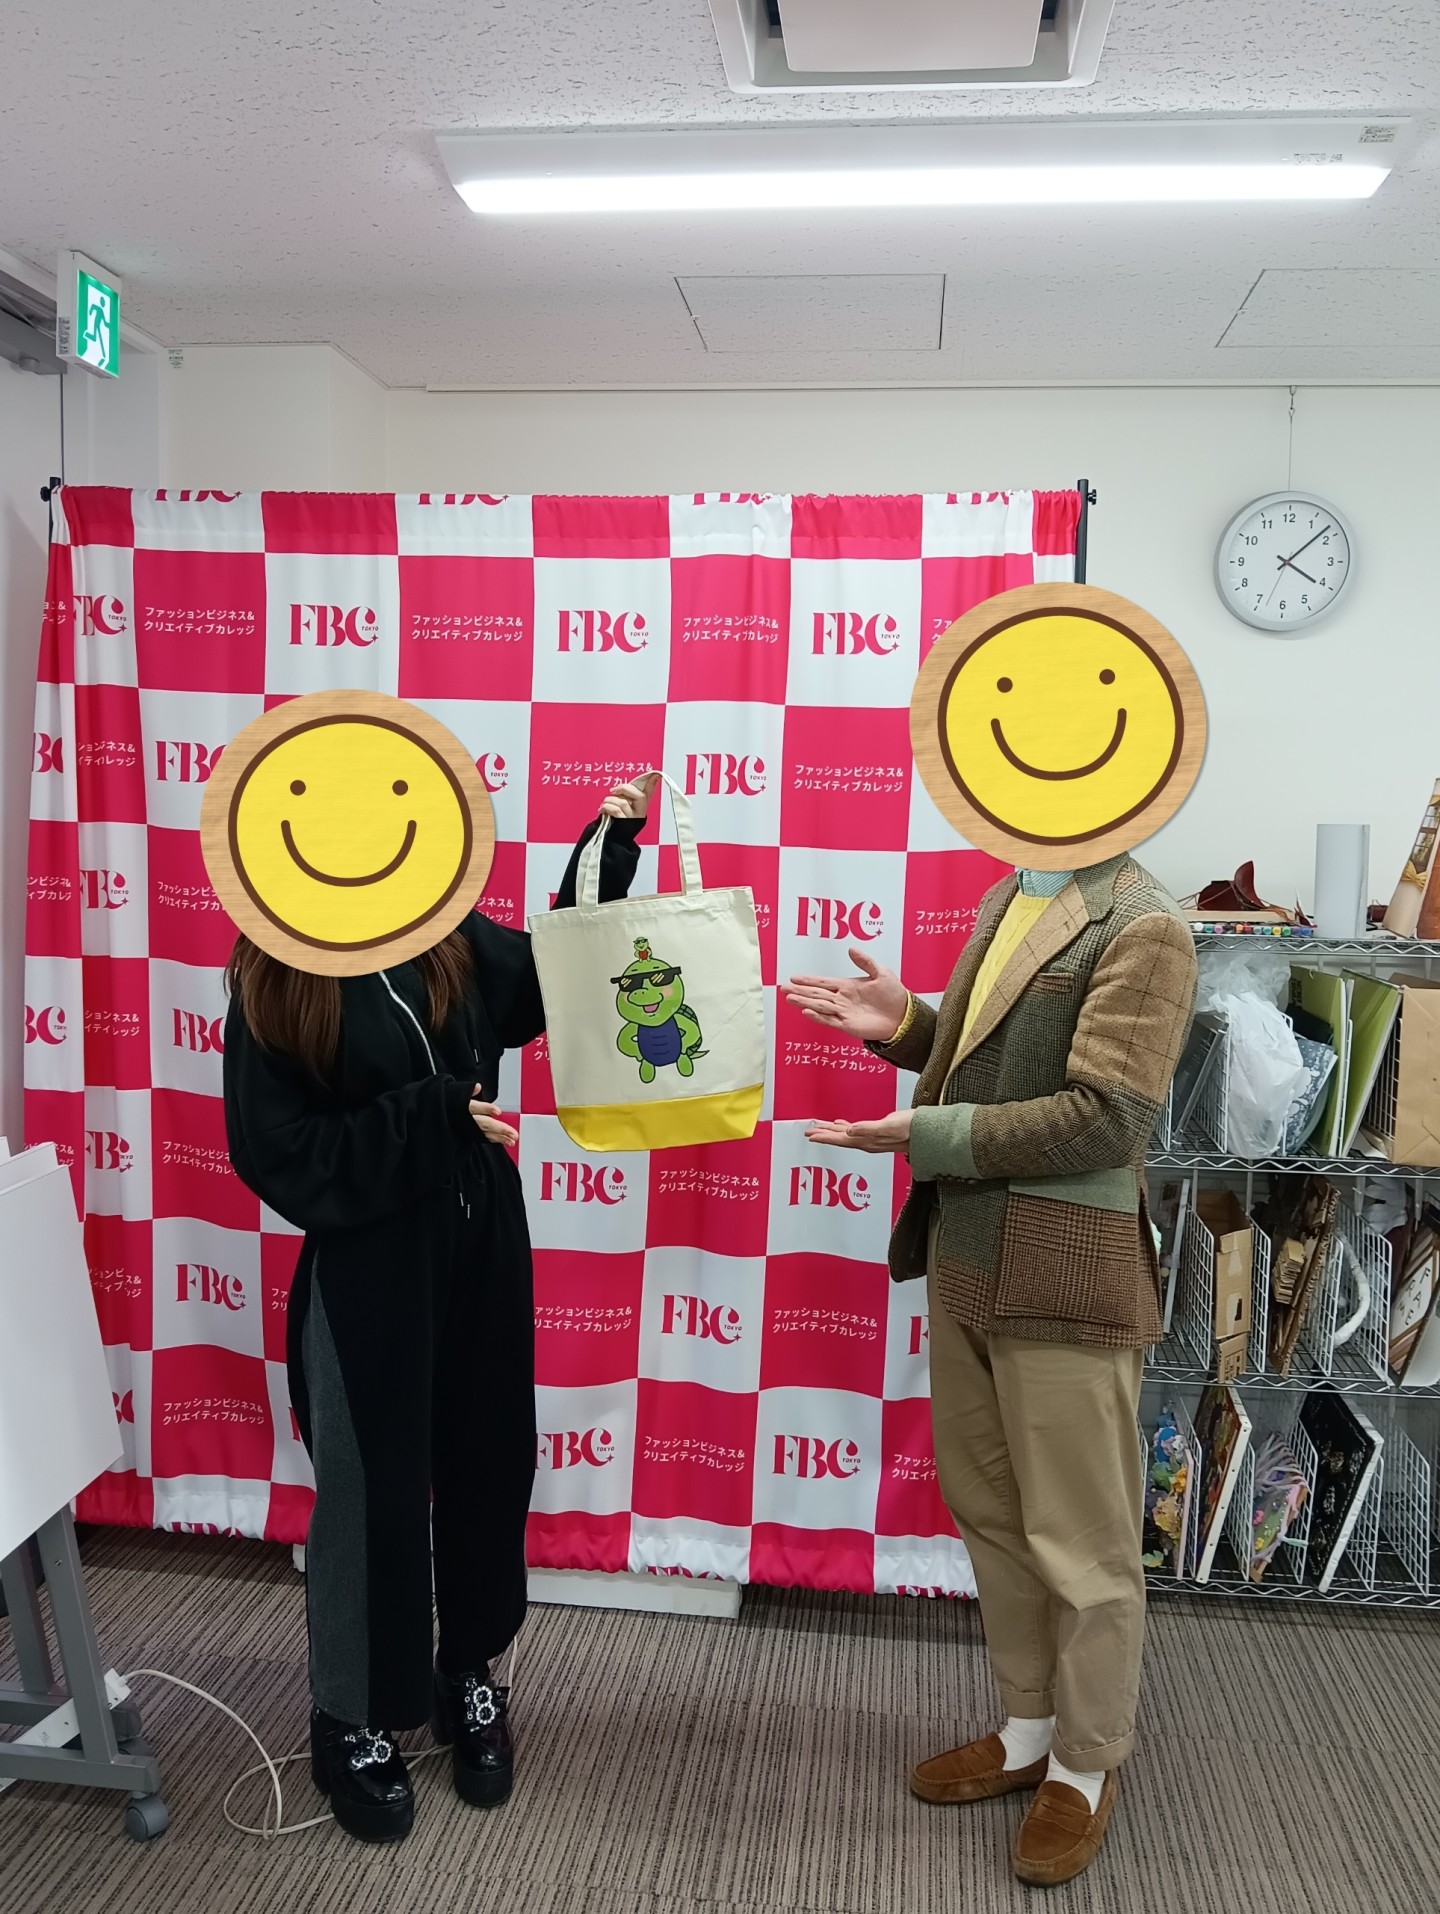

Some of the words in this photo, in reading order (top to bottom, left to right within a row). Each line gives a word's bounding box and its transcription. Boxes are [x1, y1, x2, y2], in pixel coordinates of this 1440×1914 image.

[1262, 519, 1273, 529] 11
[1283, 513, 1296, 523] 12
[1308, 520, 1313, 529] 1
[1245, 536, 1258, 545] 10
[1322, 535, 1329, 545] 2
[1238, 557, 1245, 566] 9
[1327, 557, 1334, 566] 3
[1241, 578, 1248, 587] 8
[1319, 577, 1326, 587] 4
[1256, 594, 1263, 603] 7
[1279, 600, 1286, 610] 6
[1301, 594, 1308, 604] 5
[108, 614, 127, 622] TOKYO
[145, 606, 254, 621] ファッションビジネス&
[412, 614, 523, 627] ファッションビジネス&
[144, 620, 254, 636] クリエイティブカレッジ
[289, 603, 377, 647] FBC
[557, 610, 646, 653] FBC
[411, 629, 523, 642] クリエイティブカレッジ
[811, 612, 898, 655] FBC
[155, 741, 227, 783] FB
[542, 761, 652, 773] ファッションビジネス&
[684, 753, 765, 796] FBC
[795, 764, 903, 778] ファッションビジネス&
[541, 773, 631, 786] クリエイティブカ
[793, 778, 903, 792] クリエイティブカレッジ
[157, 881, 218, 897] ファッションビ
[158, 895, 226, 911] クリエイティブカ
[796, 896, 881, 941] FBC
[785, 1055, 887, 1073] クリエイティブカレッジ
[540, 1161, 624, 1205] FBC
[660, 1170, 759, 1187] ファッションビジネス&
[658, 1183, 759, 1201] クリエイティブカレッジ
[788, 1166, 868, 1211] FBC
[176, 1263, 243, 1311] FBC
[231, 1291, 246, 1299] TOKYO
[534, 1305, 632, 1319] ァッションビジネス&
[661, 1294, 740, 1345] FBC
[774, 1308, 878, 1328] ファッションビジネス&
[534, 1318, 632, 1333] リエイティブカレッジ
[772, 1322, 877, 1341] クリエイティブカレッジ
[163, 1398, 264, 1413] ファッションビジネス&
[162, 1409, 265, 1425] クリエイティブカレッジ
[645, 1435, 745, 1459] ファッションビジネス&
[643, 1450, 745, 1473] クリエイティブカレッジ
[772, 1434, 858, 1479] FBC
